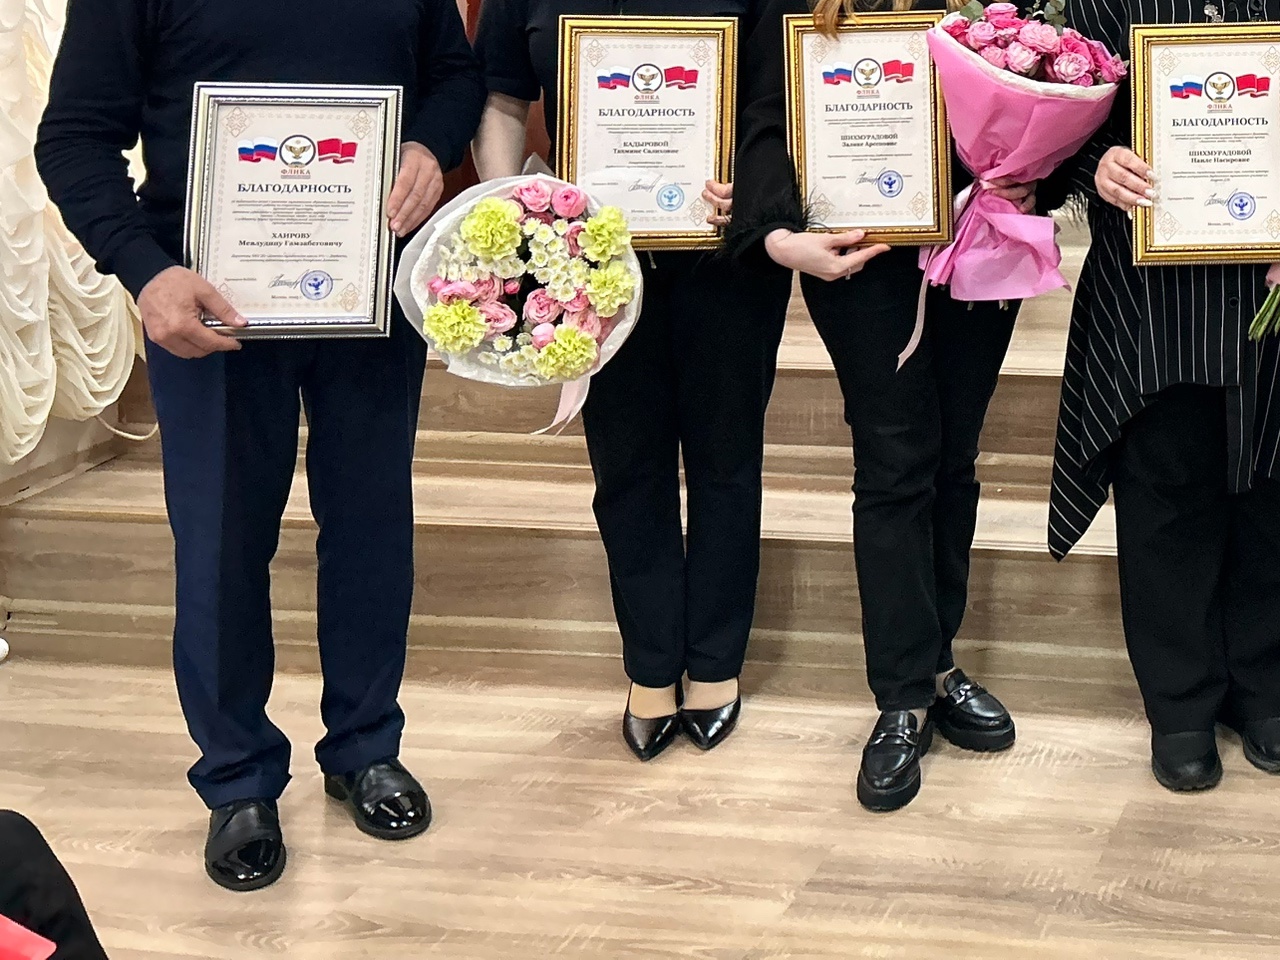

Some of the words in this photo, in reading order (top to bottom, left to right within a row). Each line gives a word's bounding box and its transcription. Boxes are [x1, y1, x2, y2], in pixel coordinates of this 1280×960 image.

[824, 102, 913, 112] БЛАГОДАРНОСТЬ
[598, 108, 696, 117] БЛАГОДАРНОСТЬ
[1172, 117, 1269, 127] БЛАГОДАРНОСТЬ
[237, 183, 352, 193] БЛАГОДАРНОСТЬ
